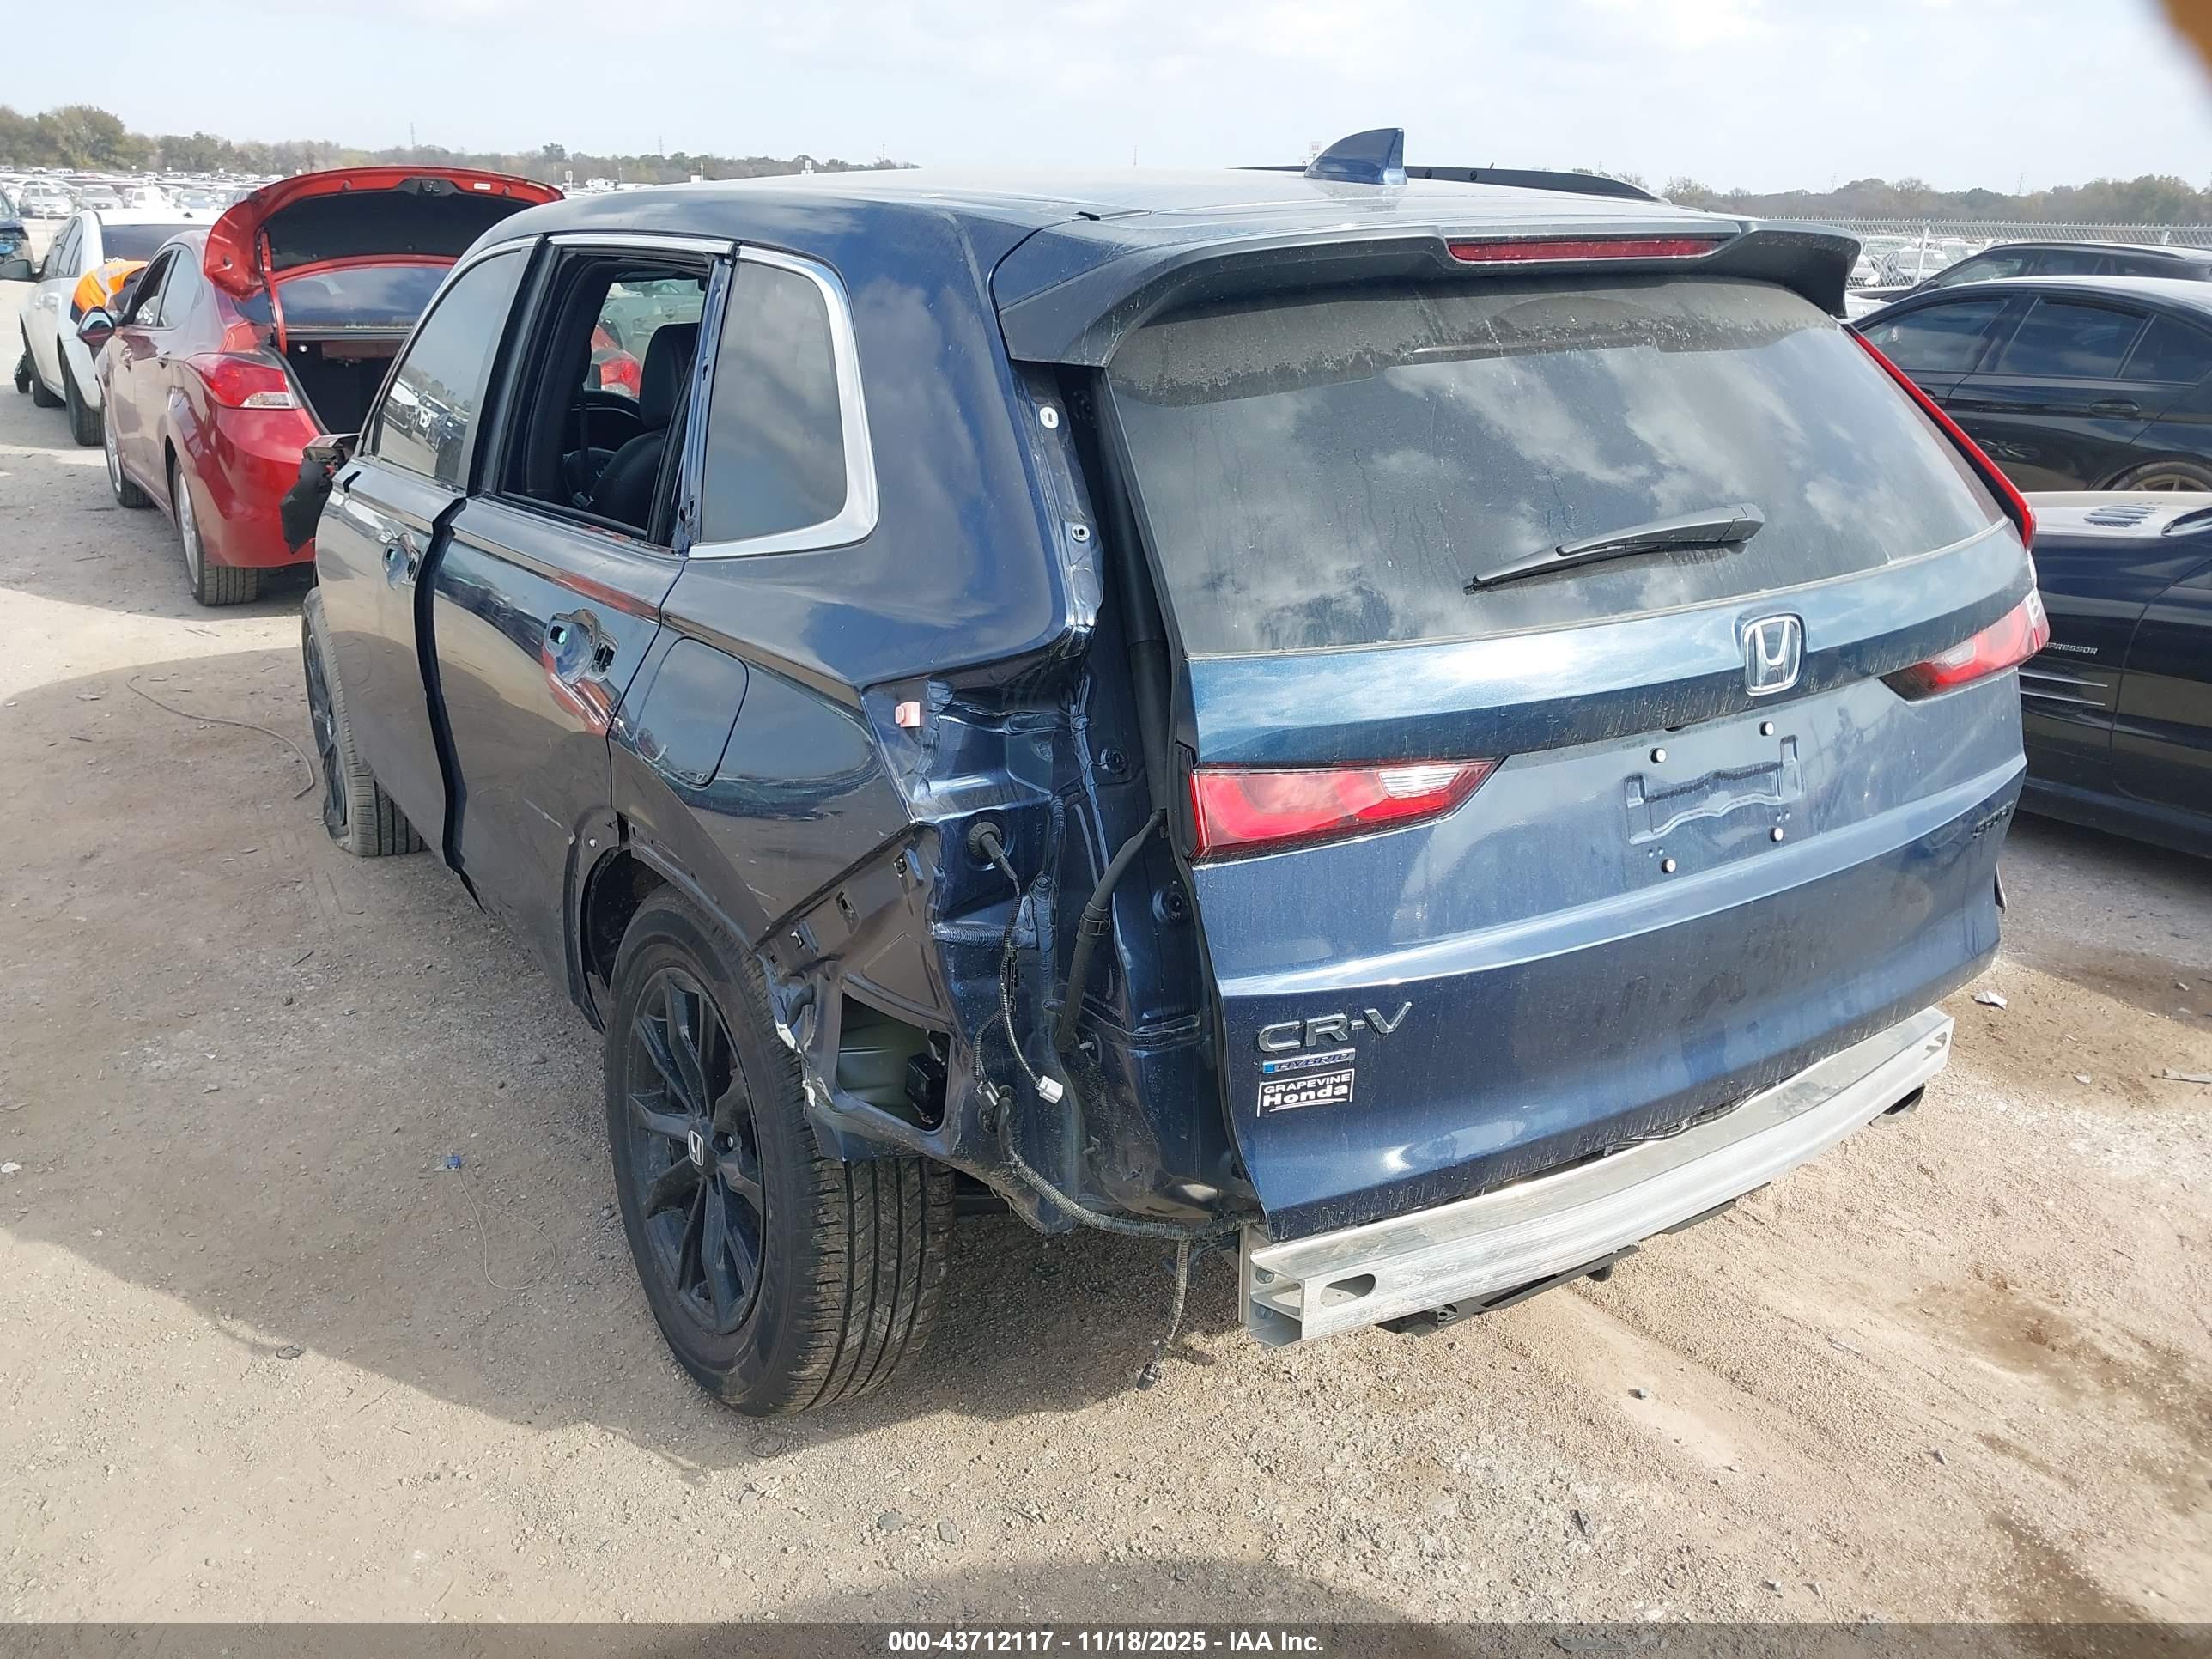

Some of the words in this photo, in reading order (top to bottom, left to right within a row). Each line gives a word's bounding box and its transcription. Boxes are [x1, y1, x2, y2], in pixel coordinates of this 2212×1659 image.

[1258, 1001, 1413, 1053] CR-V
[1277, 1053, 1351, 1071] HYBRID
[1263, 1073, 1352, 1094] GRAPEVINE
[1262, 1085, 1349, 1107] Honda
